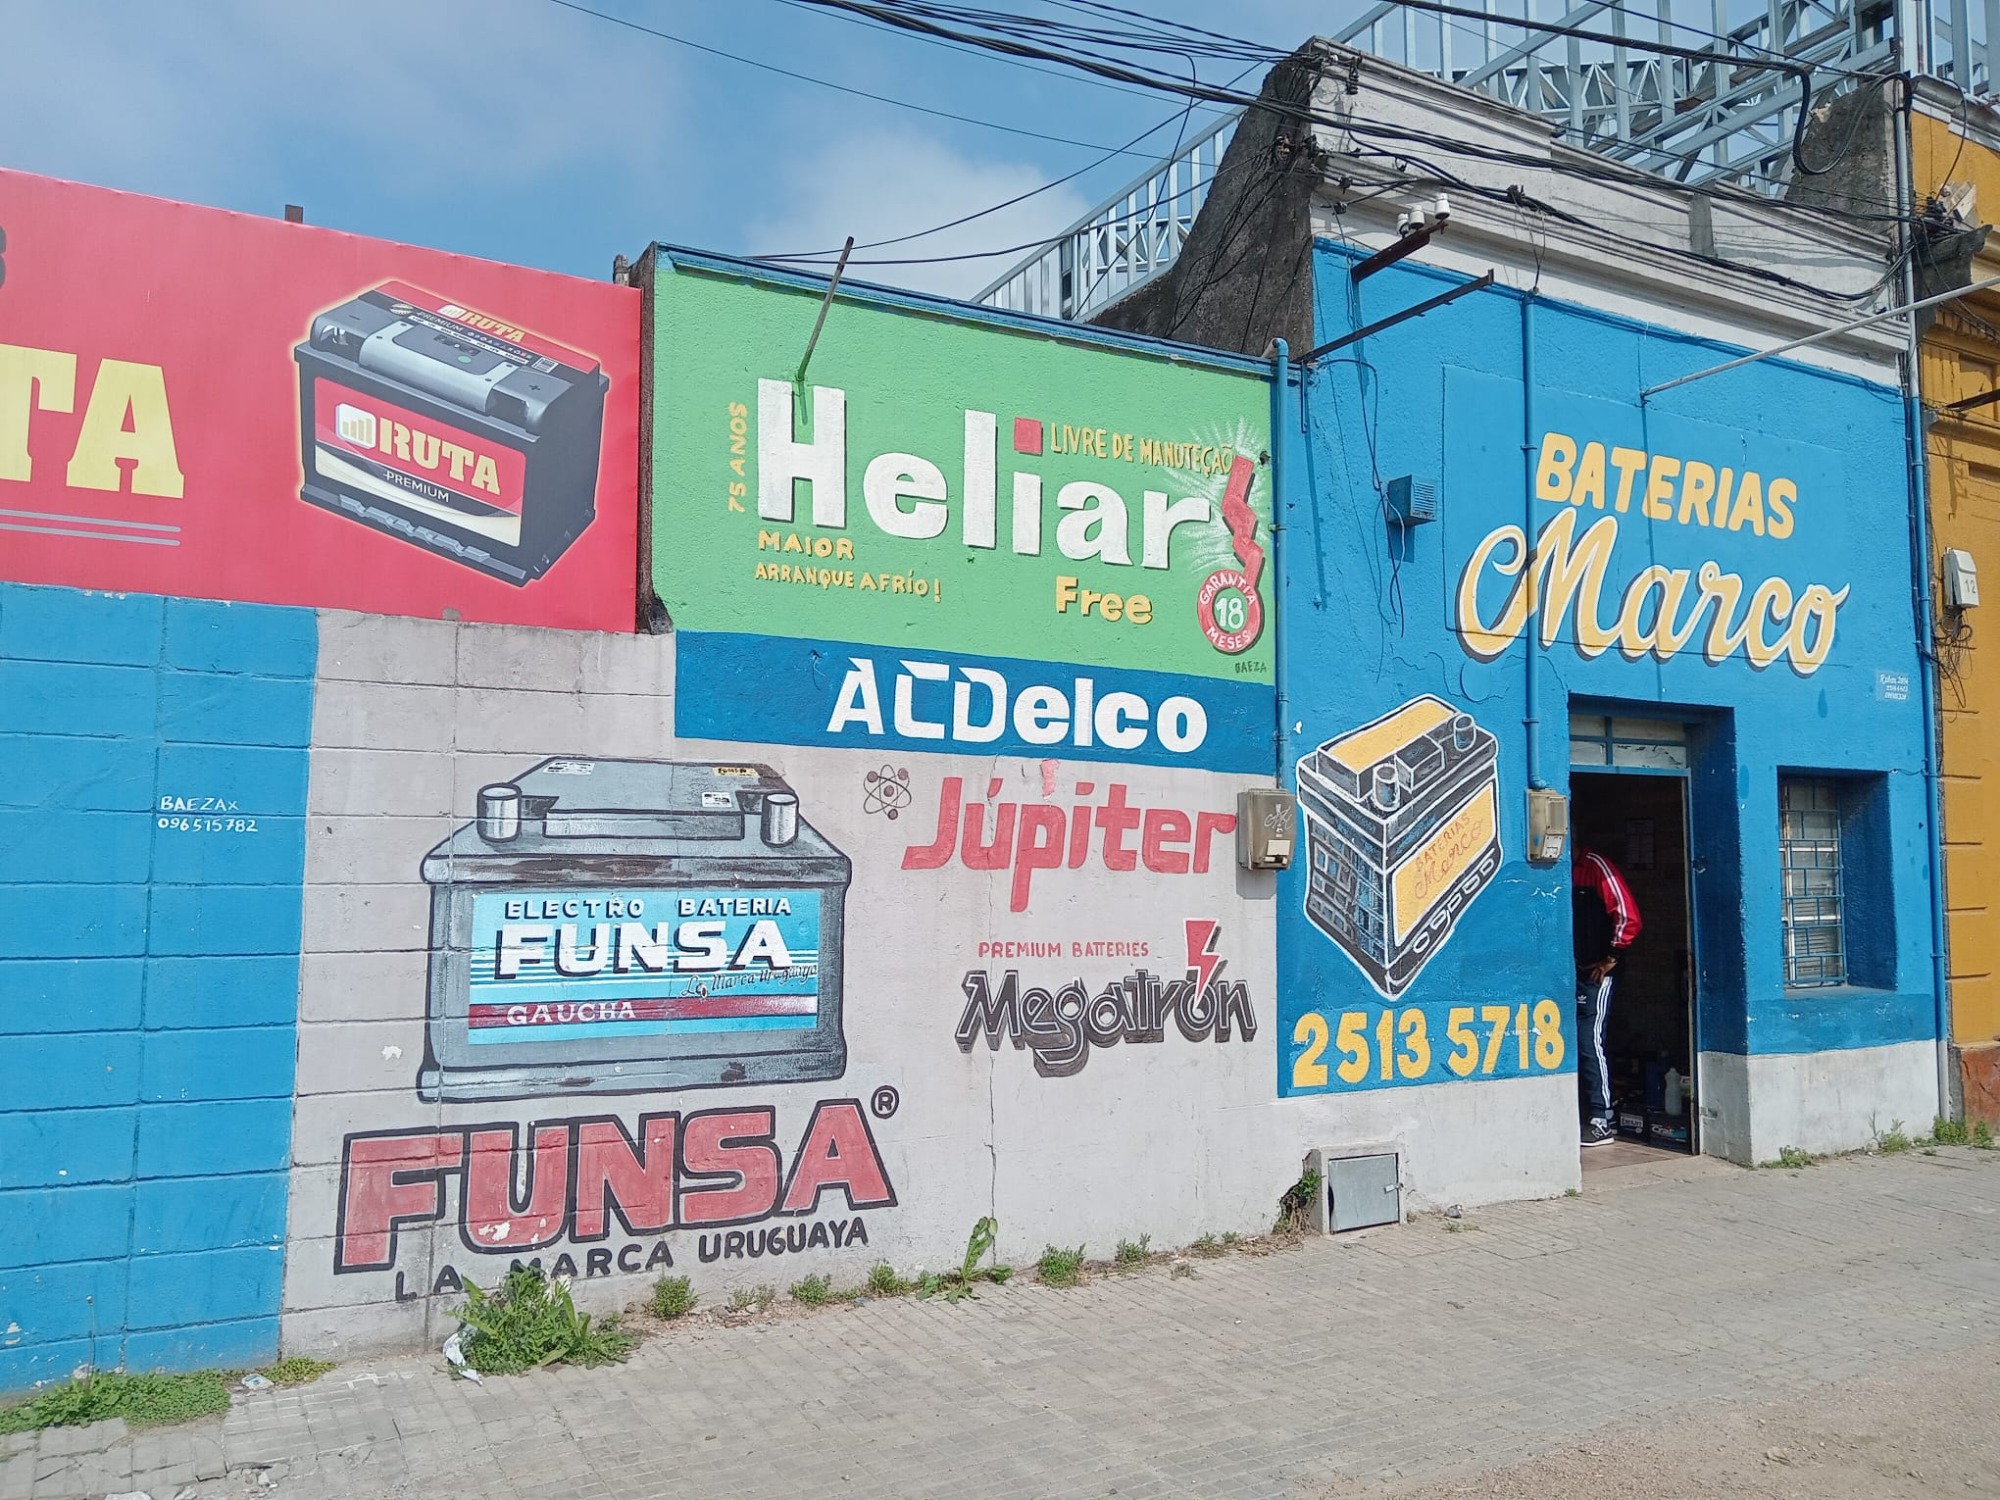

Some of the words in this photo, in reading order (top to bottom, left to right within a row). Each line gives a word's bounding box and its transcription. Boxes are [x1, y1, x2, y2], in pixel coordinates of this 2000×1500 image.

[458, 308, 526, 343] RUTA
[379, 417, 500, 495] RUTA
[728, 402, 748, 477] ANOS
[1050, 423, 1107, 459] LIVRE
[1112, 432, 1134, 462] DE
[384, 470, 450, 502] PREMIUM
[728, 481, 747, 513] 75
[757, 378, 1212, 570] Heliar
[1536, 432, 1797, 540] BATERIAS
[758, 530, 854, 560] MAIOR
[755, 562, 854, 590] ARRANQUE
[1055, 575, 1154, 625] Free
[1199, 572, 1257, 605] GARANTIA
[1455, 506, 1851, 675] Marco
[1206, 626, 1251, 649] MESES
[1215, 597, 1244, 629] 18
[826, 657, 1208, 753] ACDelco
[900, 776, 1237, 912] Júpiter
[504, 899, 645, 919] ELECTRO
[678, 897, 792, 917] BATERIA
[495, 919, 793, 980] FUNSA
[978, 941, 1062, 958] PREMIUM
[507, 1002, 637, 1026] GAUCHA
[955, 967, 1258, 1078] Megatron
[1293, 1008, 1431, 1087] 2513
[1447, 999, 1565, 1077] 5718
[333, 1098, 898, 1275] FUNSA
[395, 1265, 463, 1301] LA
[699, 1216, 869, 1263] URUGUAYA
